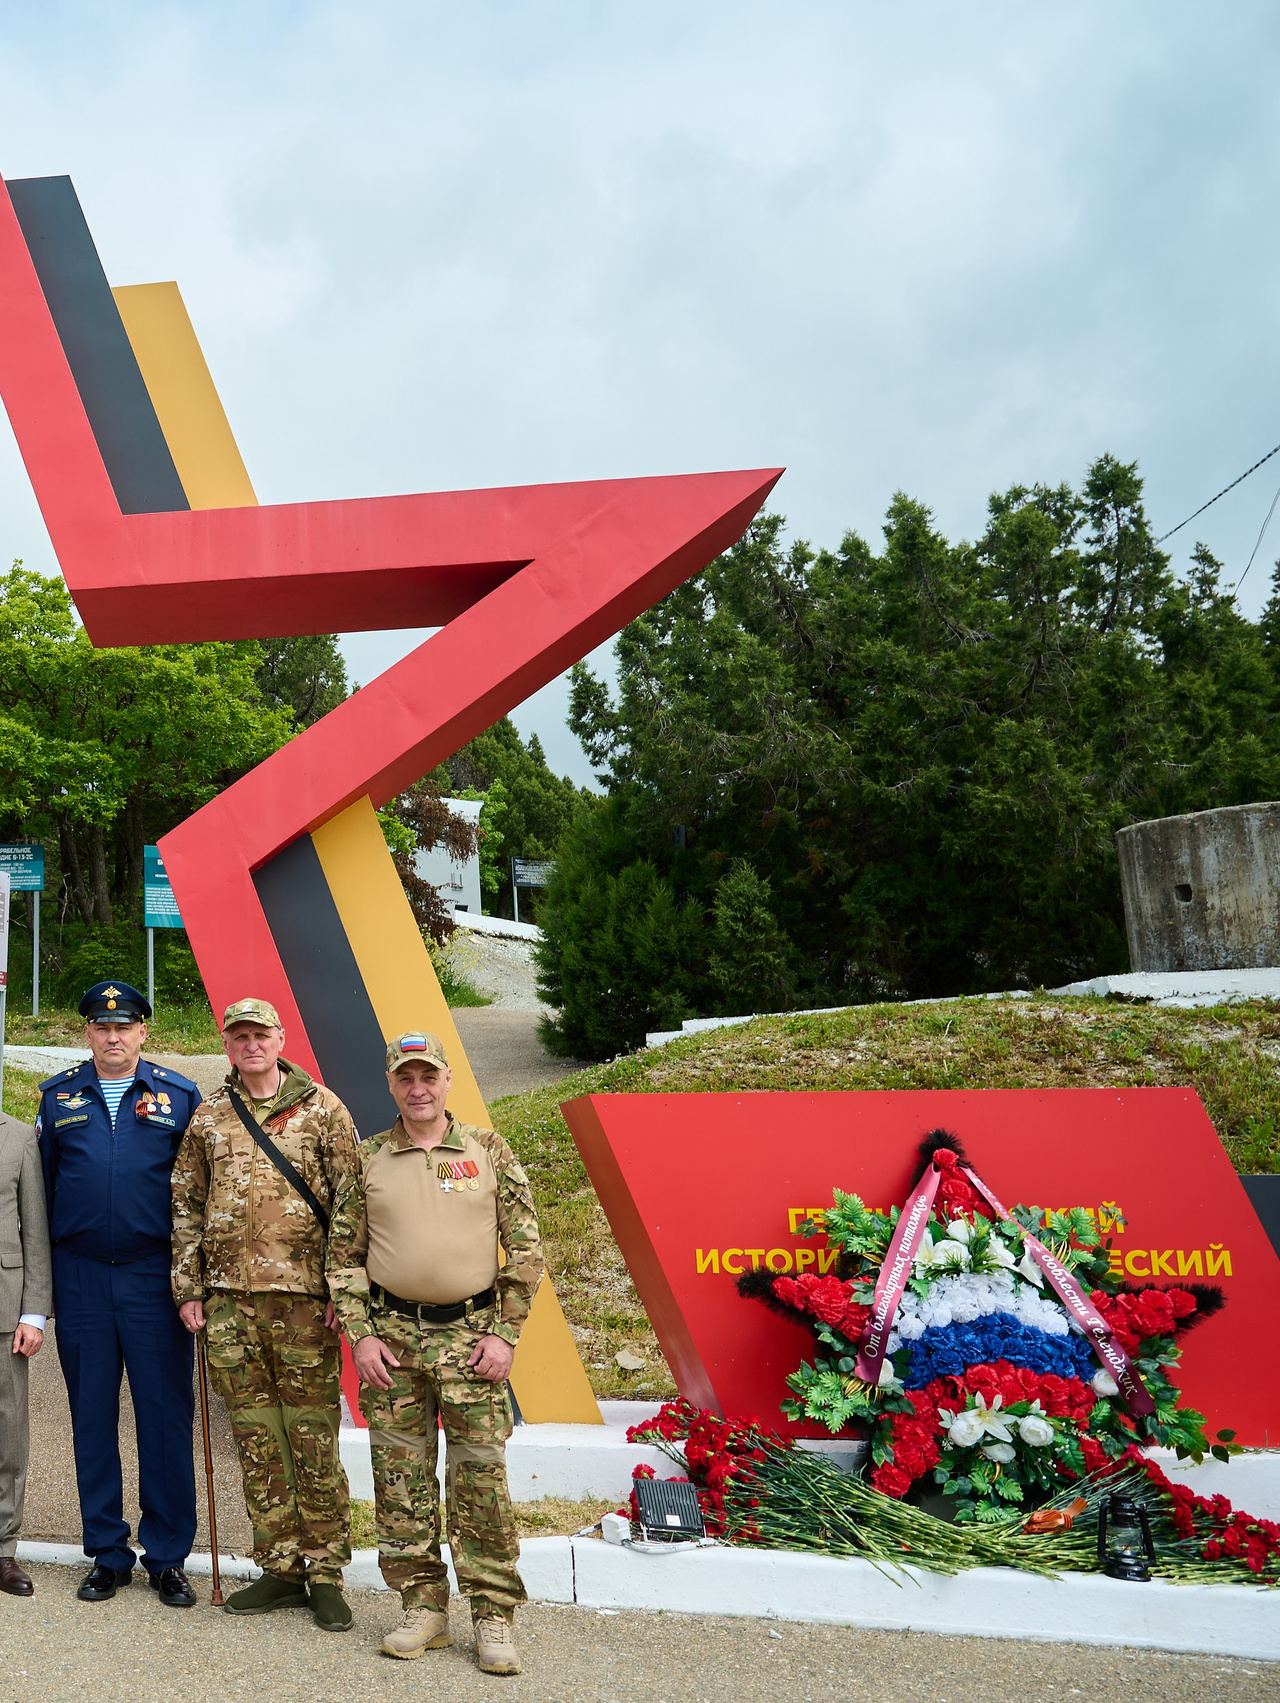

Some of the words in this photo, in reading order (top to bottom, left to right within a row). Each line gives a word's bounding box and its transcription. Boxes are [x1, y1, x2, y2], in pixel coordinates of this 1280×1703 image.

[241, 1001, 253, 1013] Z
[899, 1194, 928, 1252] потомков
[872, 1252, 910, 1332] благодарных
[864, 1333, 881, 1358] От
[1042, 1254, 1090, 1316] доблести
[1086, 1316, 1138, 1400] Геленджик
